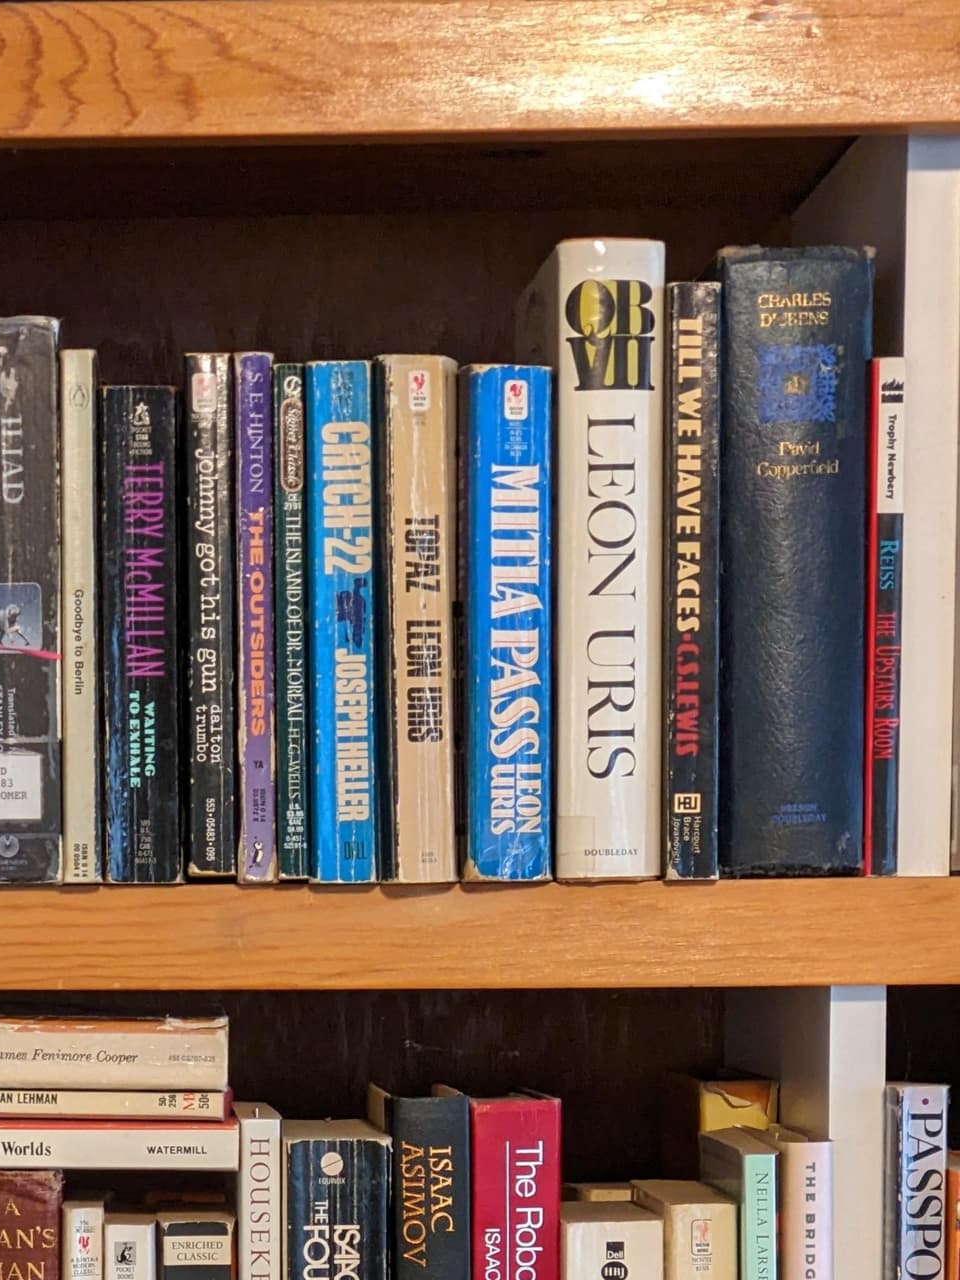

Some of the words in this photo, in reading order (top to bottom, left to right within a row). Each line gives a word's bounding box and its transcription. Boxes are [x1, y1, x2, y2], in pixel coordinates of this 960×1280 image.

[677, 317, 702, 385] TILL
[677, 387, 702, 437] WE
[887, 415, 897, 450] Trophy
[126, 461, 164, 538] TERRY
[195, 449, 220, 541] johnny
[321, 421, 373, 576] CATCH-22
[676, 445, 701, 535] HAVE
[886, 453, 896, 500] Newbery
[586, 414, 638, 600] LEON
[195, 543, 220, 588] got
[676, 542, 700, 633] FACES
[73, 590, 84, 641] Goodbye
[126, 548, 165, 678] McMILLAN
[200, 594, 221, 641] his
[74, 645, 84, 657] to
[196, 649, 217, 694] gun
[74, 661, 84, 696] Berlin
[336, 648, 368, 737] JOSEPH
[586, 625, 637, 781] URIS
[196, 704, 207, 763] trumbo
[210, 704, 223, 763] dalton
[336, 743, 370, 821] HELLER
[585, 849, 640, 858] DOUBLEDAY
[32, 1049, 91, 1062] Fenimore
[96, 1051, 138, 1064] Cooper
[17, 1093, 58, 1105] LEHMAN
[0, 1141, 52, 1156] Worlds
[147, 1146, 207, 1155] WATERMILL
[514, 1140, 543, 1198] The
[755, 1172, 769, 1226] NELLA
[172, 1241, 223, 1250] ENRICHED
[177, 1252, 218, 1261] CLASSIC
